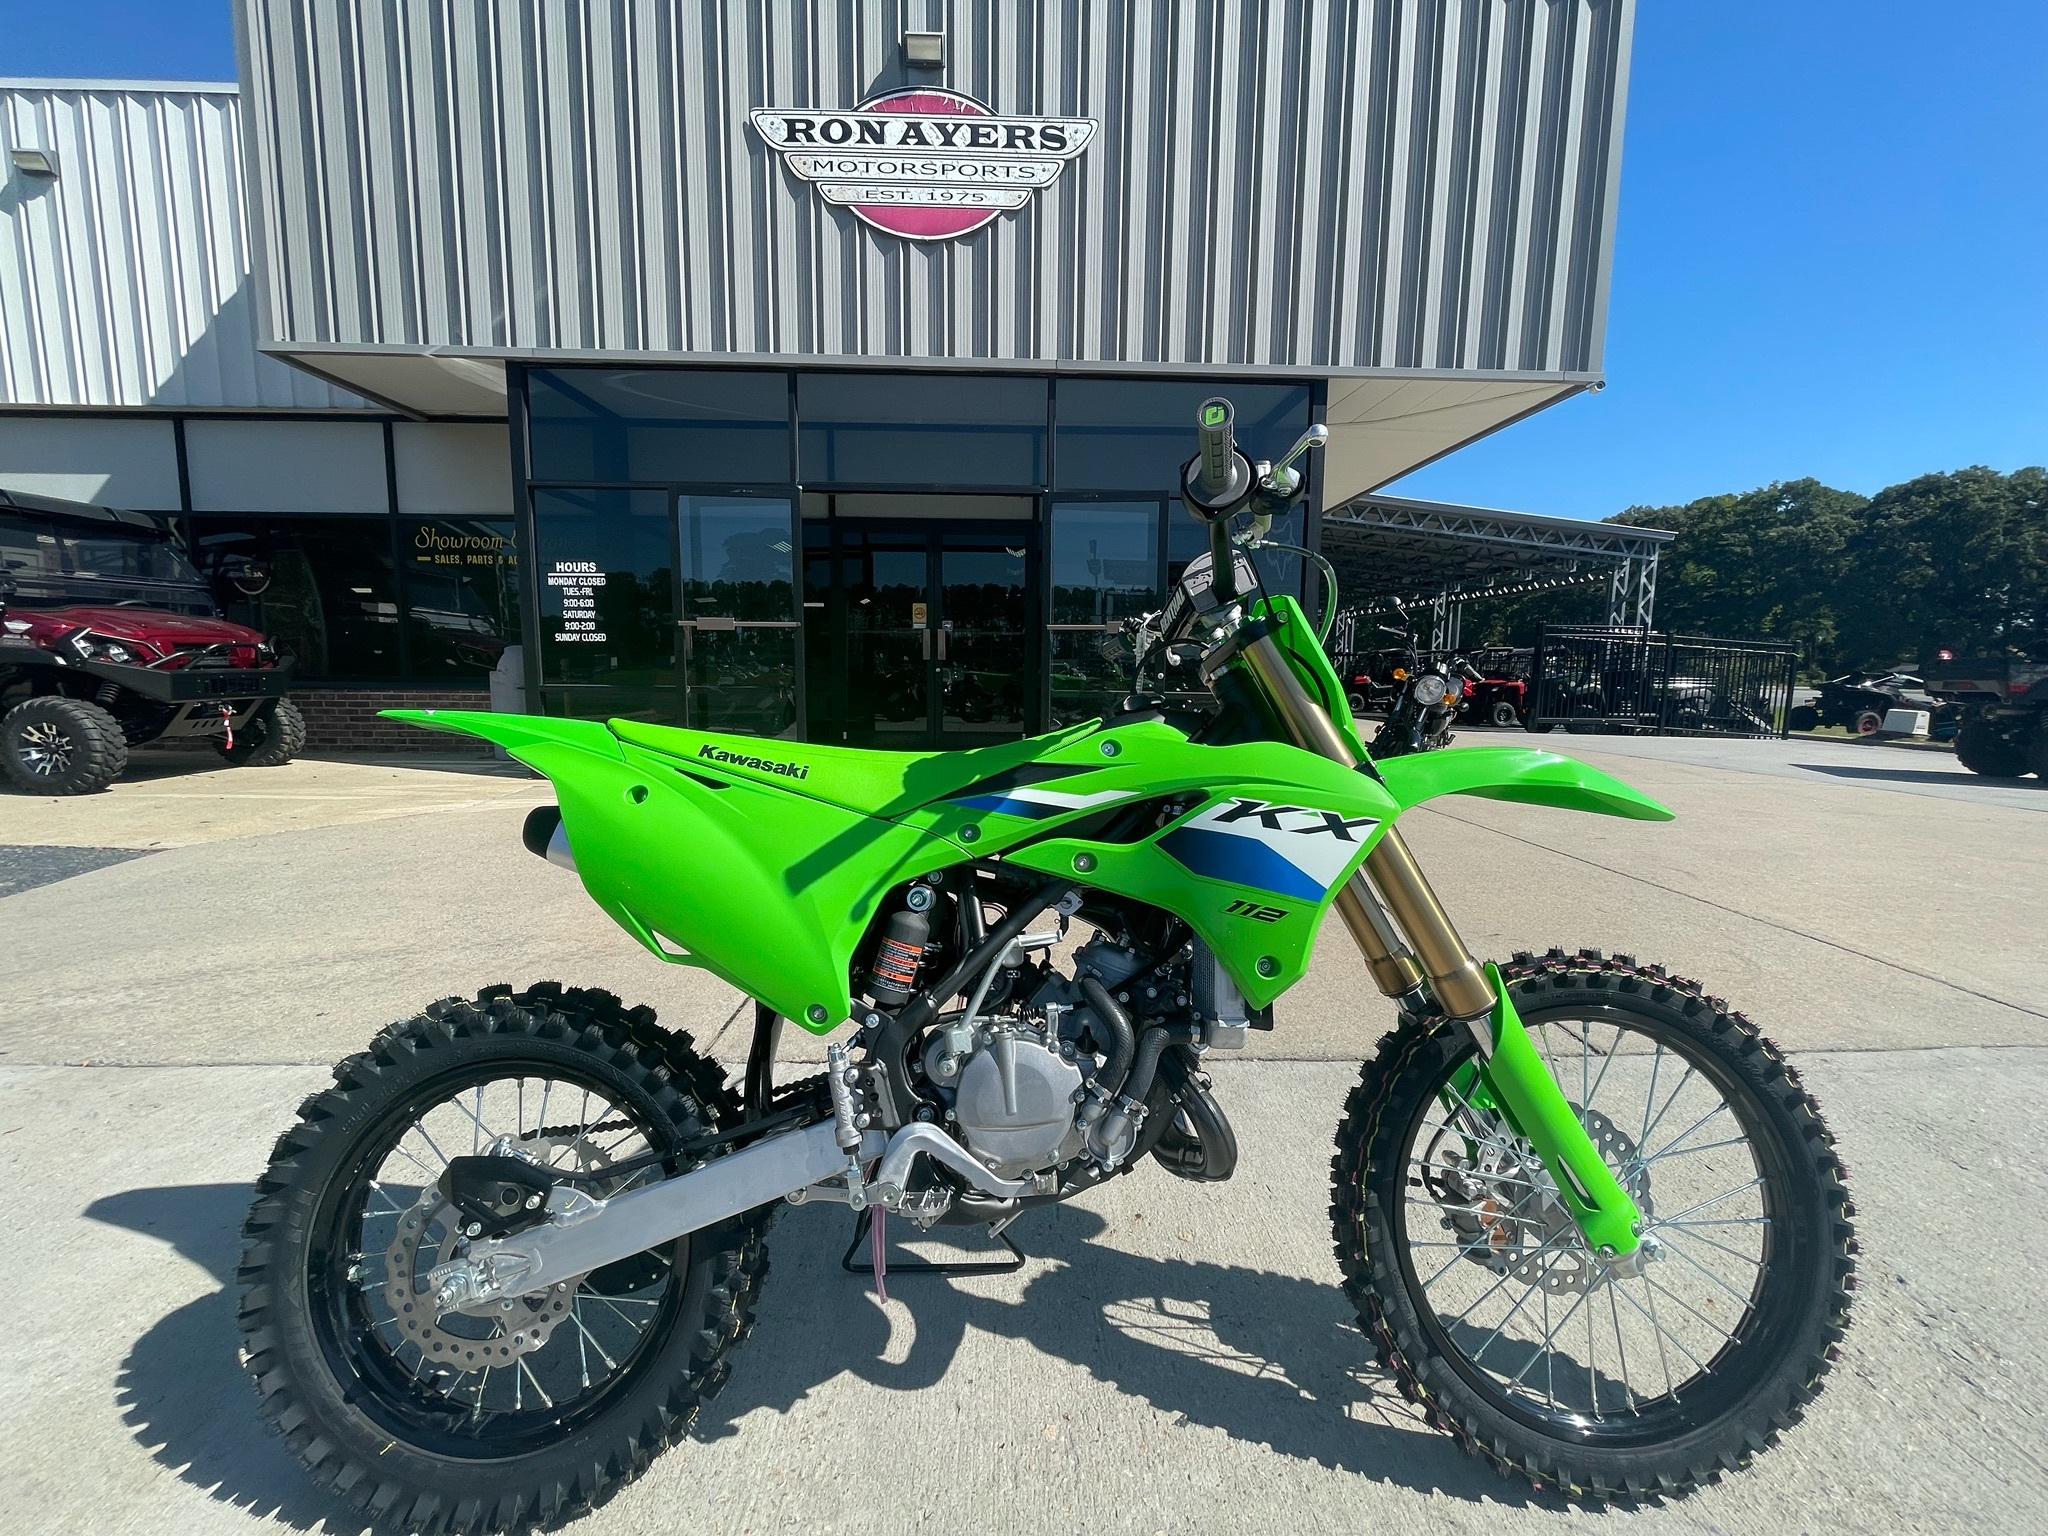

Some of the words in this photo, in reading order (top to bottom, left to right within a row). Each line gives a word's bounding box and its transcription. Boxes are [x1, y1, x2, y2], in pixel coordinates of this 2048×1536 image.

[781, 118, 890, 145] RON
[896, 121, 1068, 151] AYERS
[813, 160, 1036, 179] MOTORSPORTS
[865, 190, 914, 200] EST.
[926, 190, 985, 202] 1975
[415, 526, 503, 550] Showroom
[434, 554, 463, 566] SALES,
[467, 555, 494, 565] PARTS
[555, 561, 597, 573] HOURS
[547, 576, 577, 586] MONDAY
[578, 576, 606, 586] CLOSED
[563, 598, 594, 608] 9:00-6:00
[562, 610, 596, 619] SATURDAY
[564, 621, 596, 631] 9:00-2:00
[554, 632, 580, 642] SUNDAY
[581, 632, 607, 642] CLOSED
[698, 744, 810, 780] Kawasaki
[1211, 798, 1382, 844] KX
[1224, 899, 1290, 923] 112
